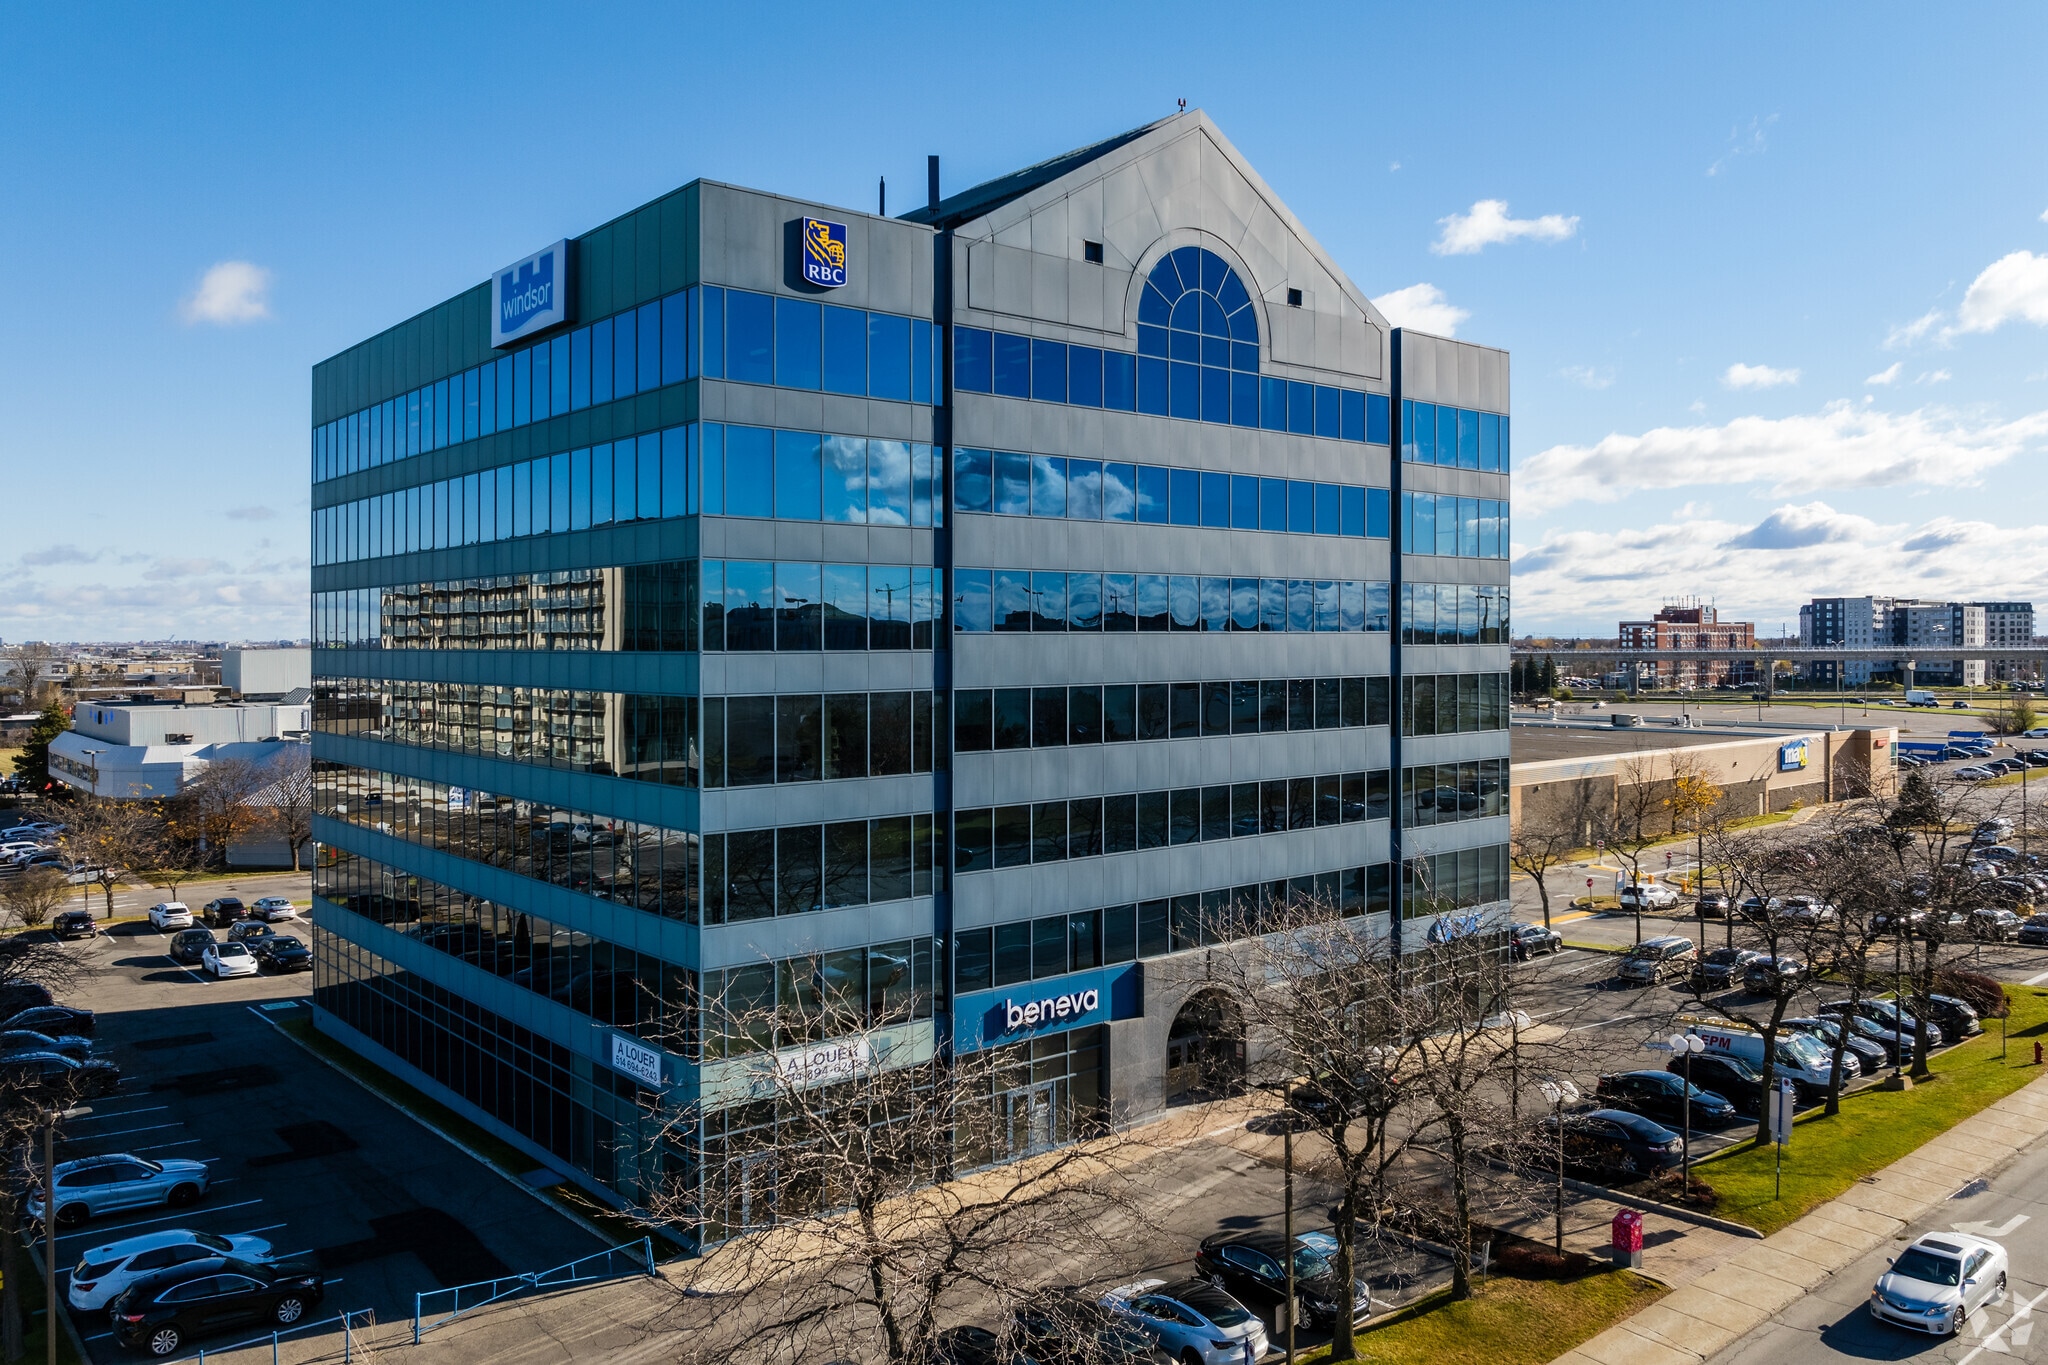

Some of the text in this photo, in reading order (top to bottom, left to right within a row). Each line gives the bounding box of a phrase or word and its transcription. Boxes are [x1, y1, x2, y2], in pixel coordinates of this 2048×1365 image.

[808, 264, 843, 283] RBC
[503, 282, 551, 320] windsor
[1006, 989, 1098, 1028] beneva
[1701, 1034, 1731, 1050] EPM
[617, 1042, 655, 1069] A LOUER
[787, 1057, 798, 1071] A
